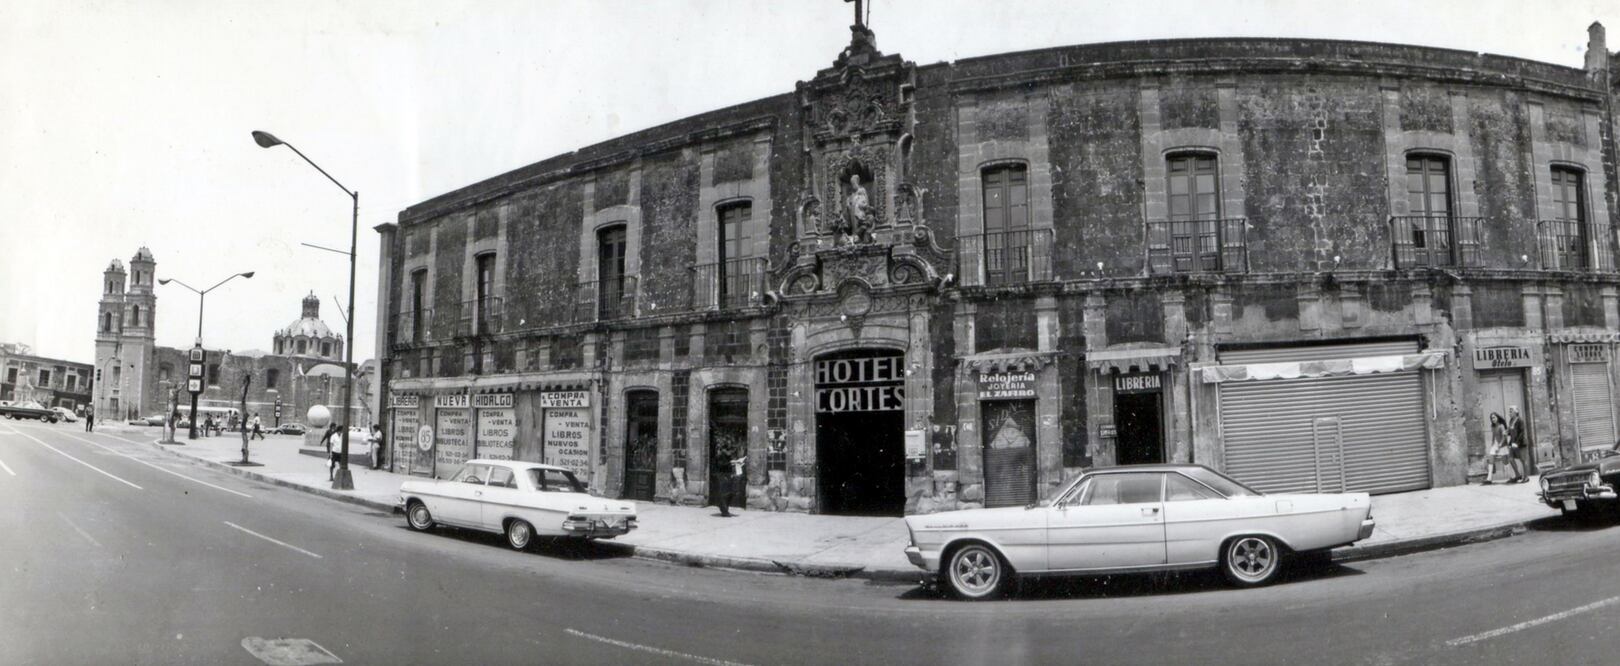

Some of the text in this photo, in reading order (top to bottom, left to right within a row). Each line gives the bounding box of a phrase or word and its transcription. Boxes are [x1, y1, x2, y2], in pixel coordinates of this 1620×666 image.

[1476, 348, 1530, 361] LIBRERIA
[815, 356, 904, 384] HOTEL
[979, 371, 1035, 384] Relojería
[1115, 375, 1161, 391] LIBRERIA
[547, 392, 585, 400] COMPRA
[993, 389, 1035, 397] ZAFIRO
[437, 395, 511, 406] NUEVA HIDALGO
[815, 387, 904, 413] CORTES
[421, 430, 431, 443] 85
[441, 428, 465, 436] LIBROS
[483, 429, 509, 437] LIBROS
[552, 431, 582, 439] LIBROS
[547, 440, 578, 448] NUEVOS
